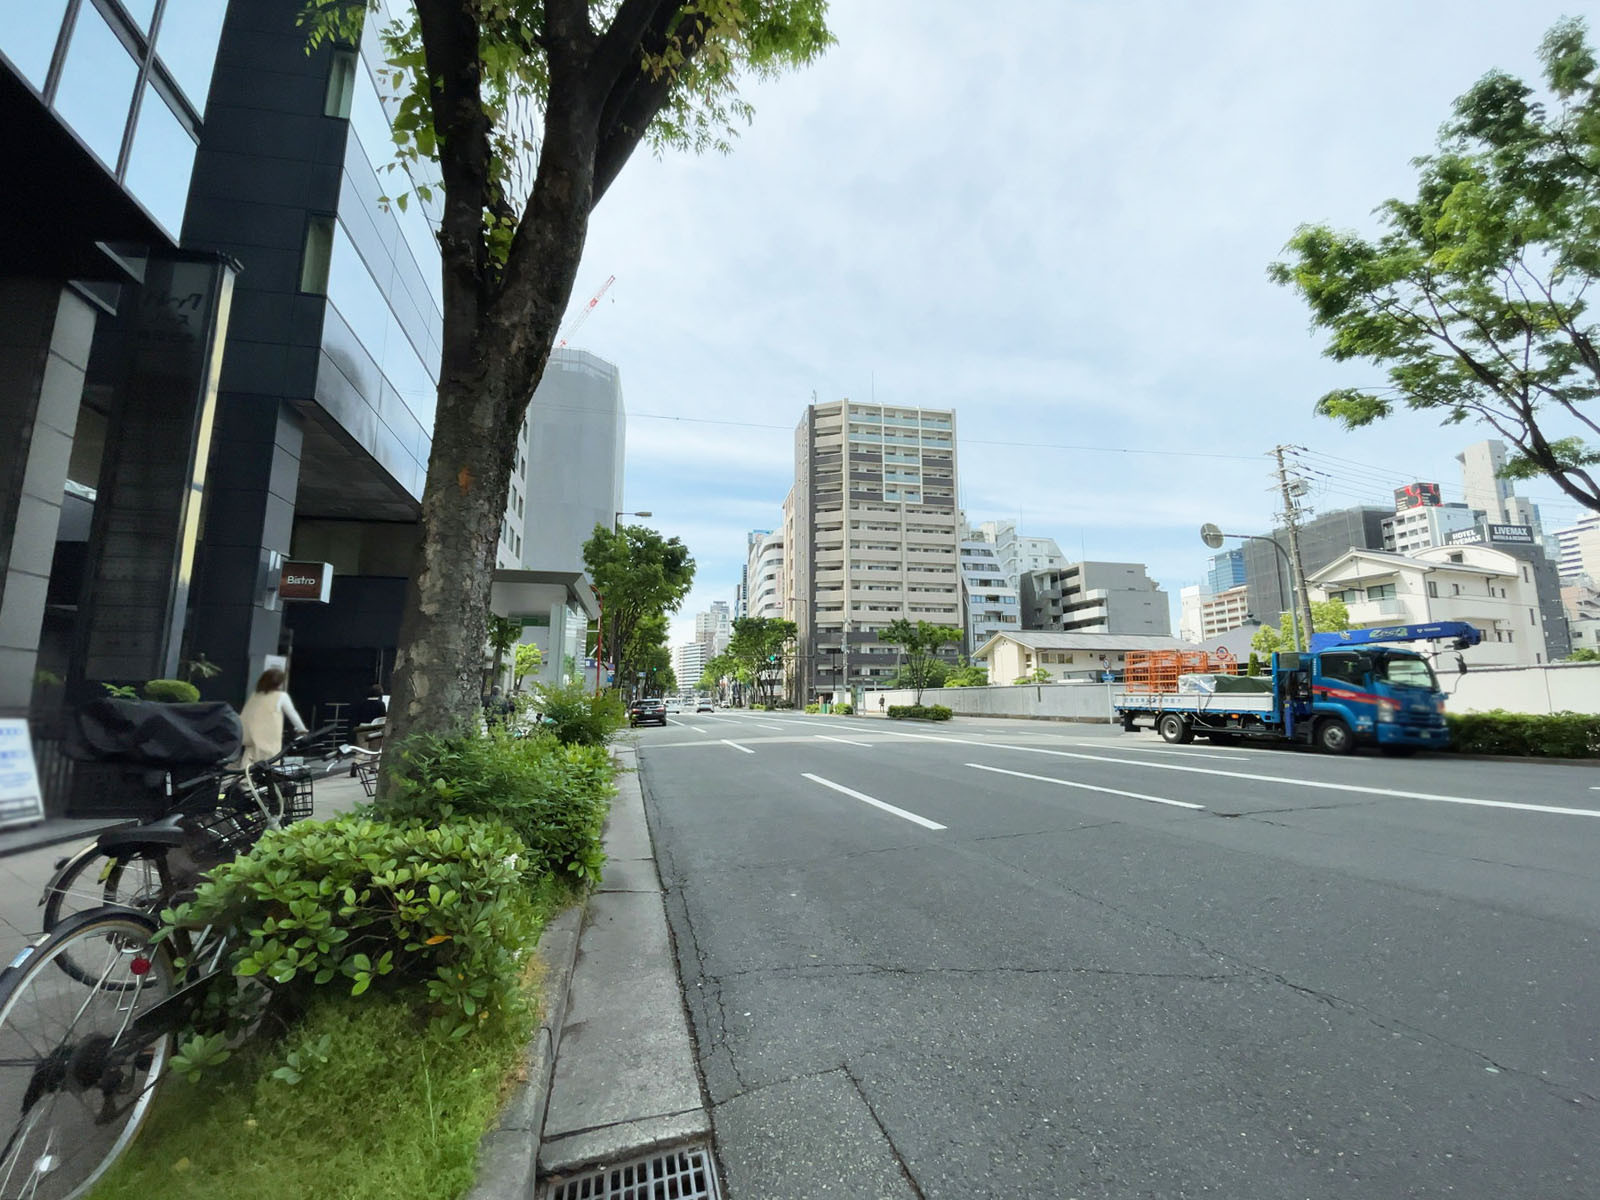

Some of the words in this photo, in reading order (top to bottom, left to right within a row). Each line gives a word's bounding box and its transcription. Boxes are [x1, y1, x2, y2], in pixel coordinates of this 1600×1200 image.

[1452, 529, 1477, 540] HOTEL
[1493, 526, 1528, 536] LIVEMAX
[287, 575, 316, 585] Bistro
